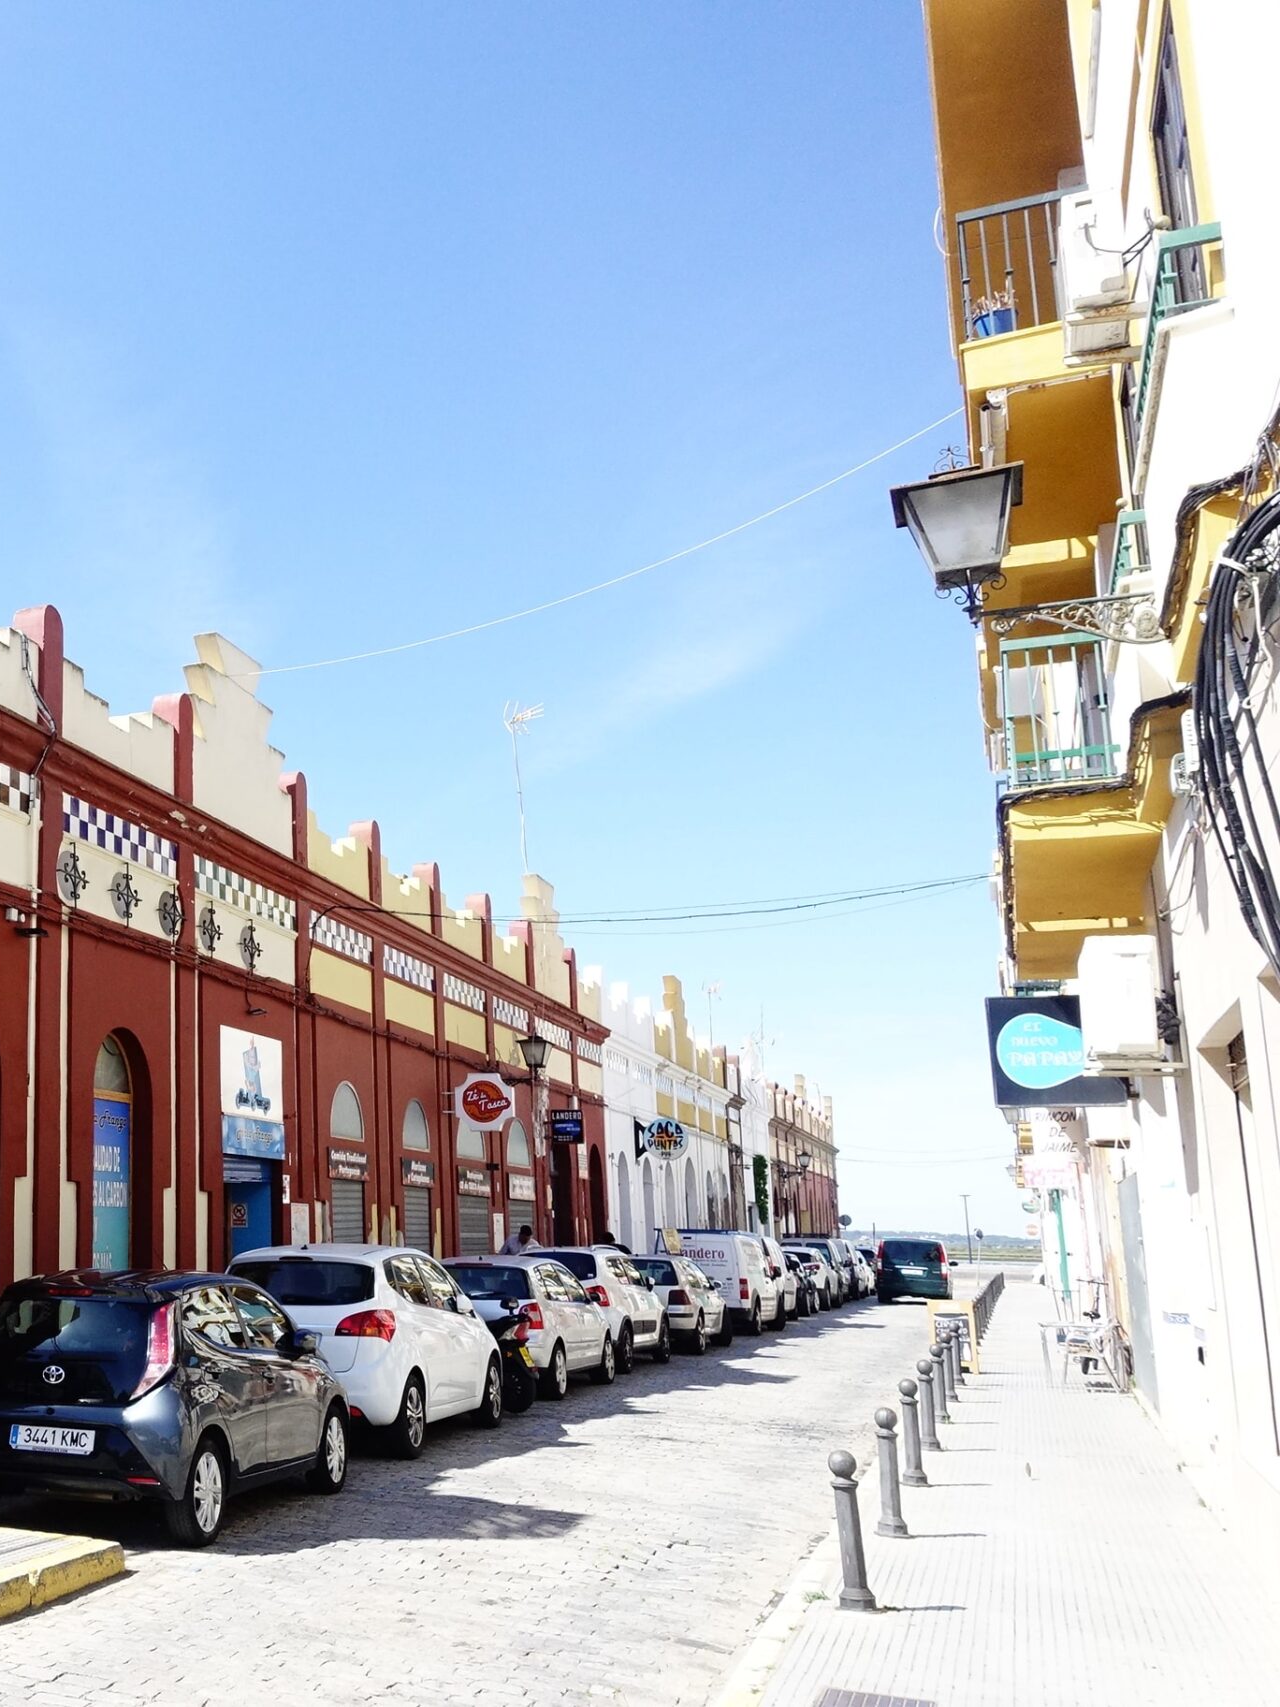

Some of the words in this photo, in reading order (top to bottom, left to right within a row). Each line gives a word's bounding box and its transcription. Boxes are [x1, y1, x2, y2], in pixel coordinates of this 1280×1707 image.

[479, 1099, 508, 1111] Tasca
[551, 1111, 582, 1120] LANDERO
[1035, 1111, 1077, 1122] RINCON
[647, 1121, 684, 1138] SACA
[1049, 1126, 1067, 1137] DE
[647, 1139, 684, 1151] PUNTAS
[1041, 1142, 1078, 1153] JAIME
[680, 1248, 725, 1259] andero
[23, 1427, 57, 1445] 3441
[60, 1430, 90, 1448] KMC
